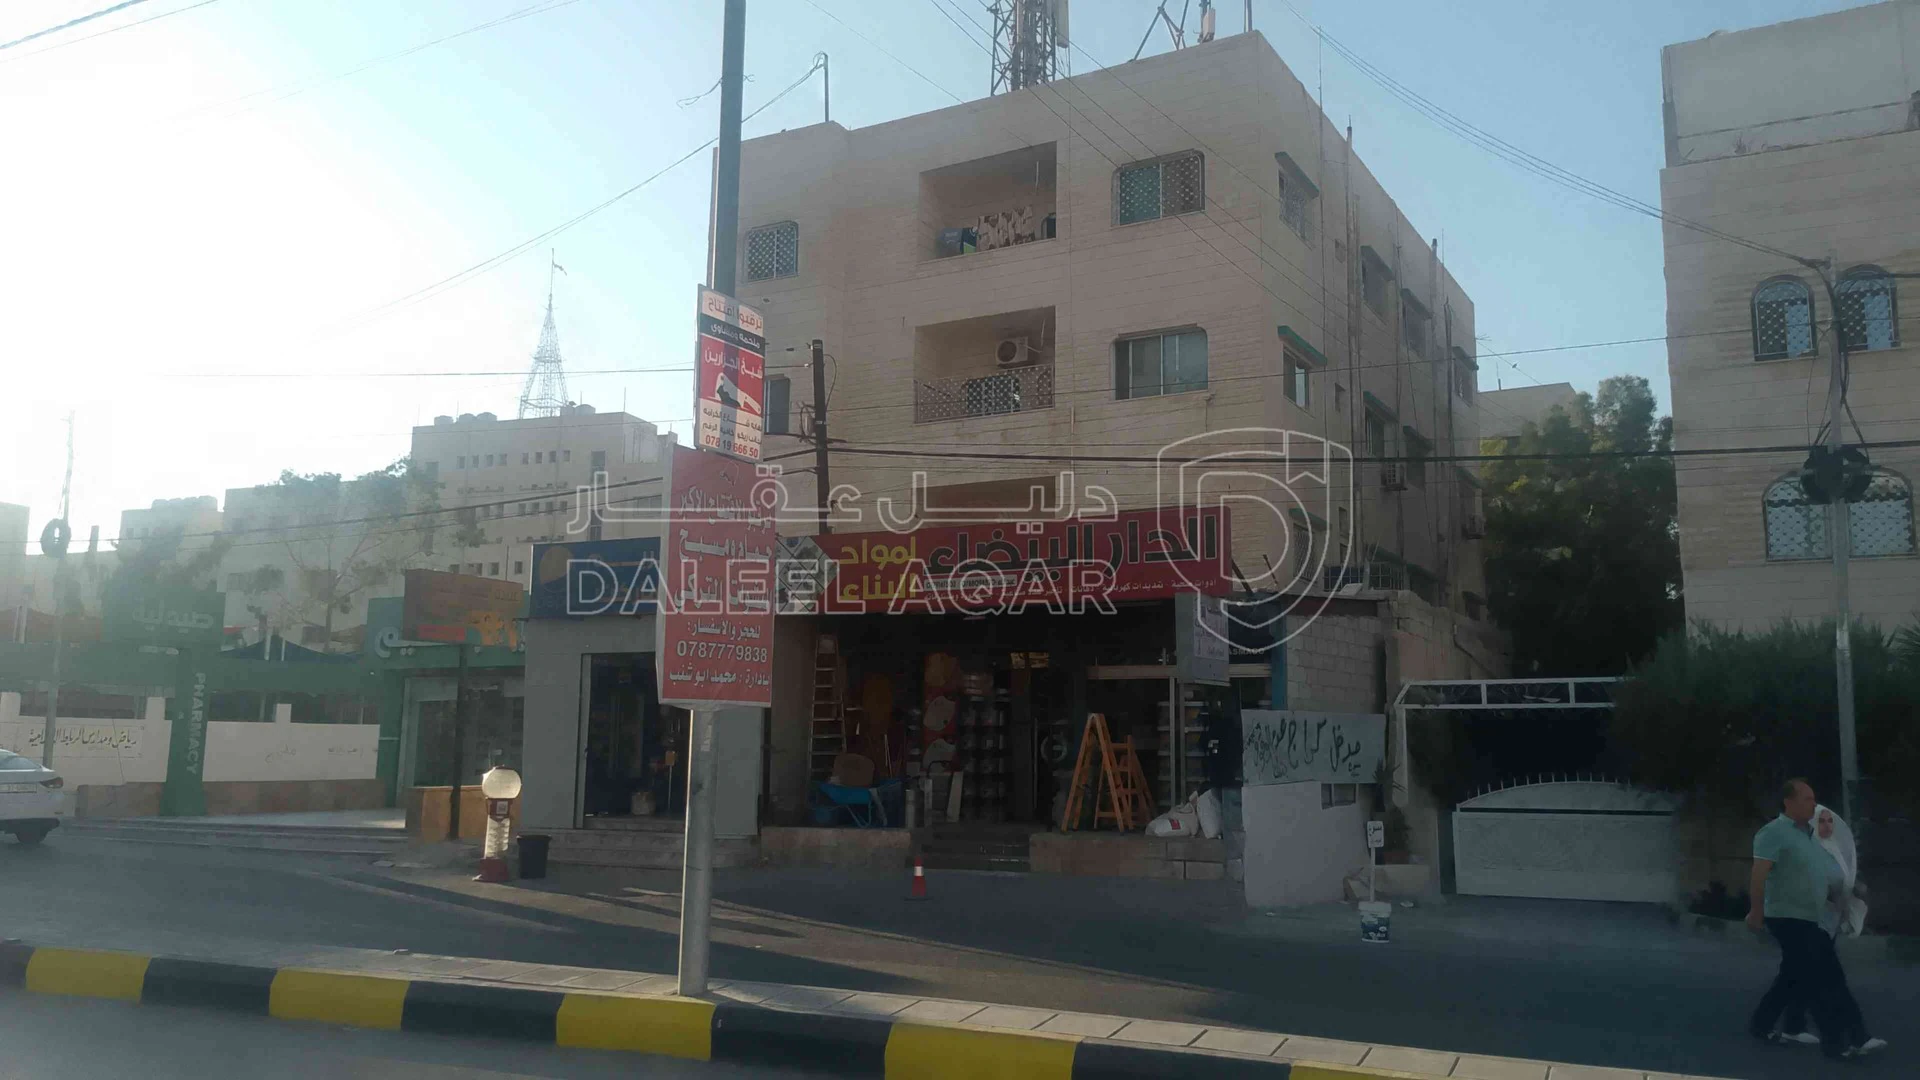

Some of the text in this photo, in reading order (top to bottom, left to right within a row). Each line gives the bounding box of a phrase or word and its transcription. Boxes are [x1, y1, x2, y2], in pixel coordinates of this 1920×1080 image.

[708, 296, 763, 331] ترقبوا افتتاح
[704, 345, 763, 379] شيخ الجزارين
[705, 434, 759, 458] 078 19 666 50
[839, 535, 917, 571] لمواد
[923, 514, 1218, 583] الدار البيضاء
[840, 571, 917, 608] البناء
[132, 597, 214, 635] صيدلية
[736, 620, 761, 641] للحجز
[676, 640, 768, 663] 0787779838
[693, 668, 709, 687] ابو
[710, 670, 737, 684] محمد
[186, 672, 206, 775] PHARMACY
